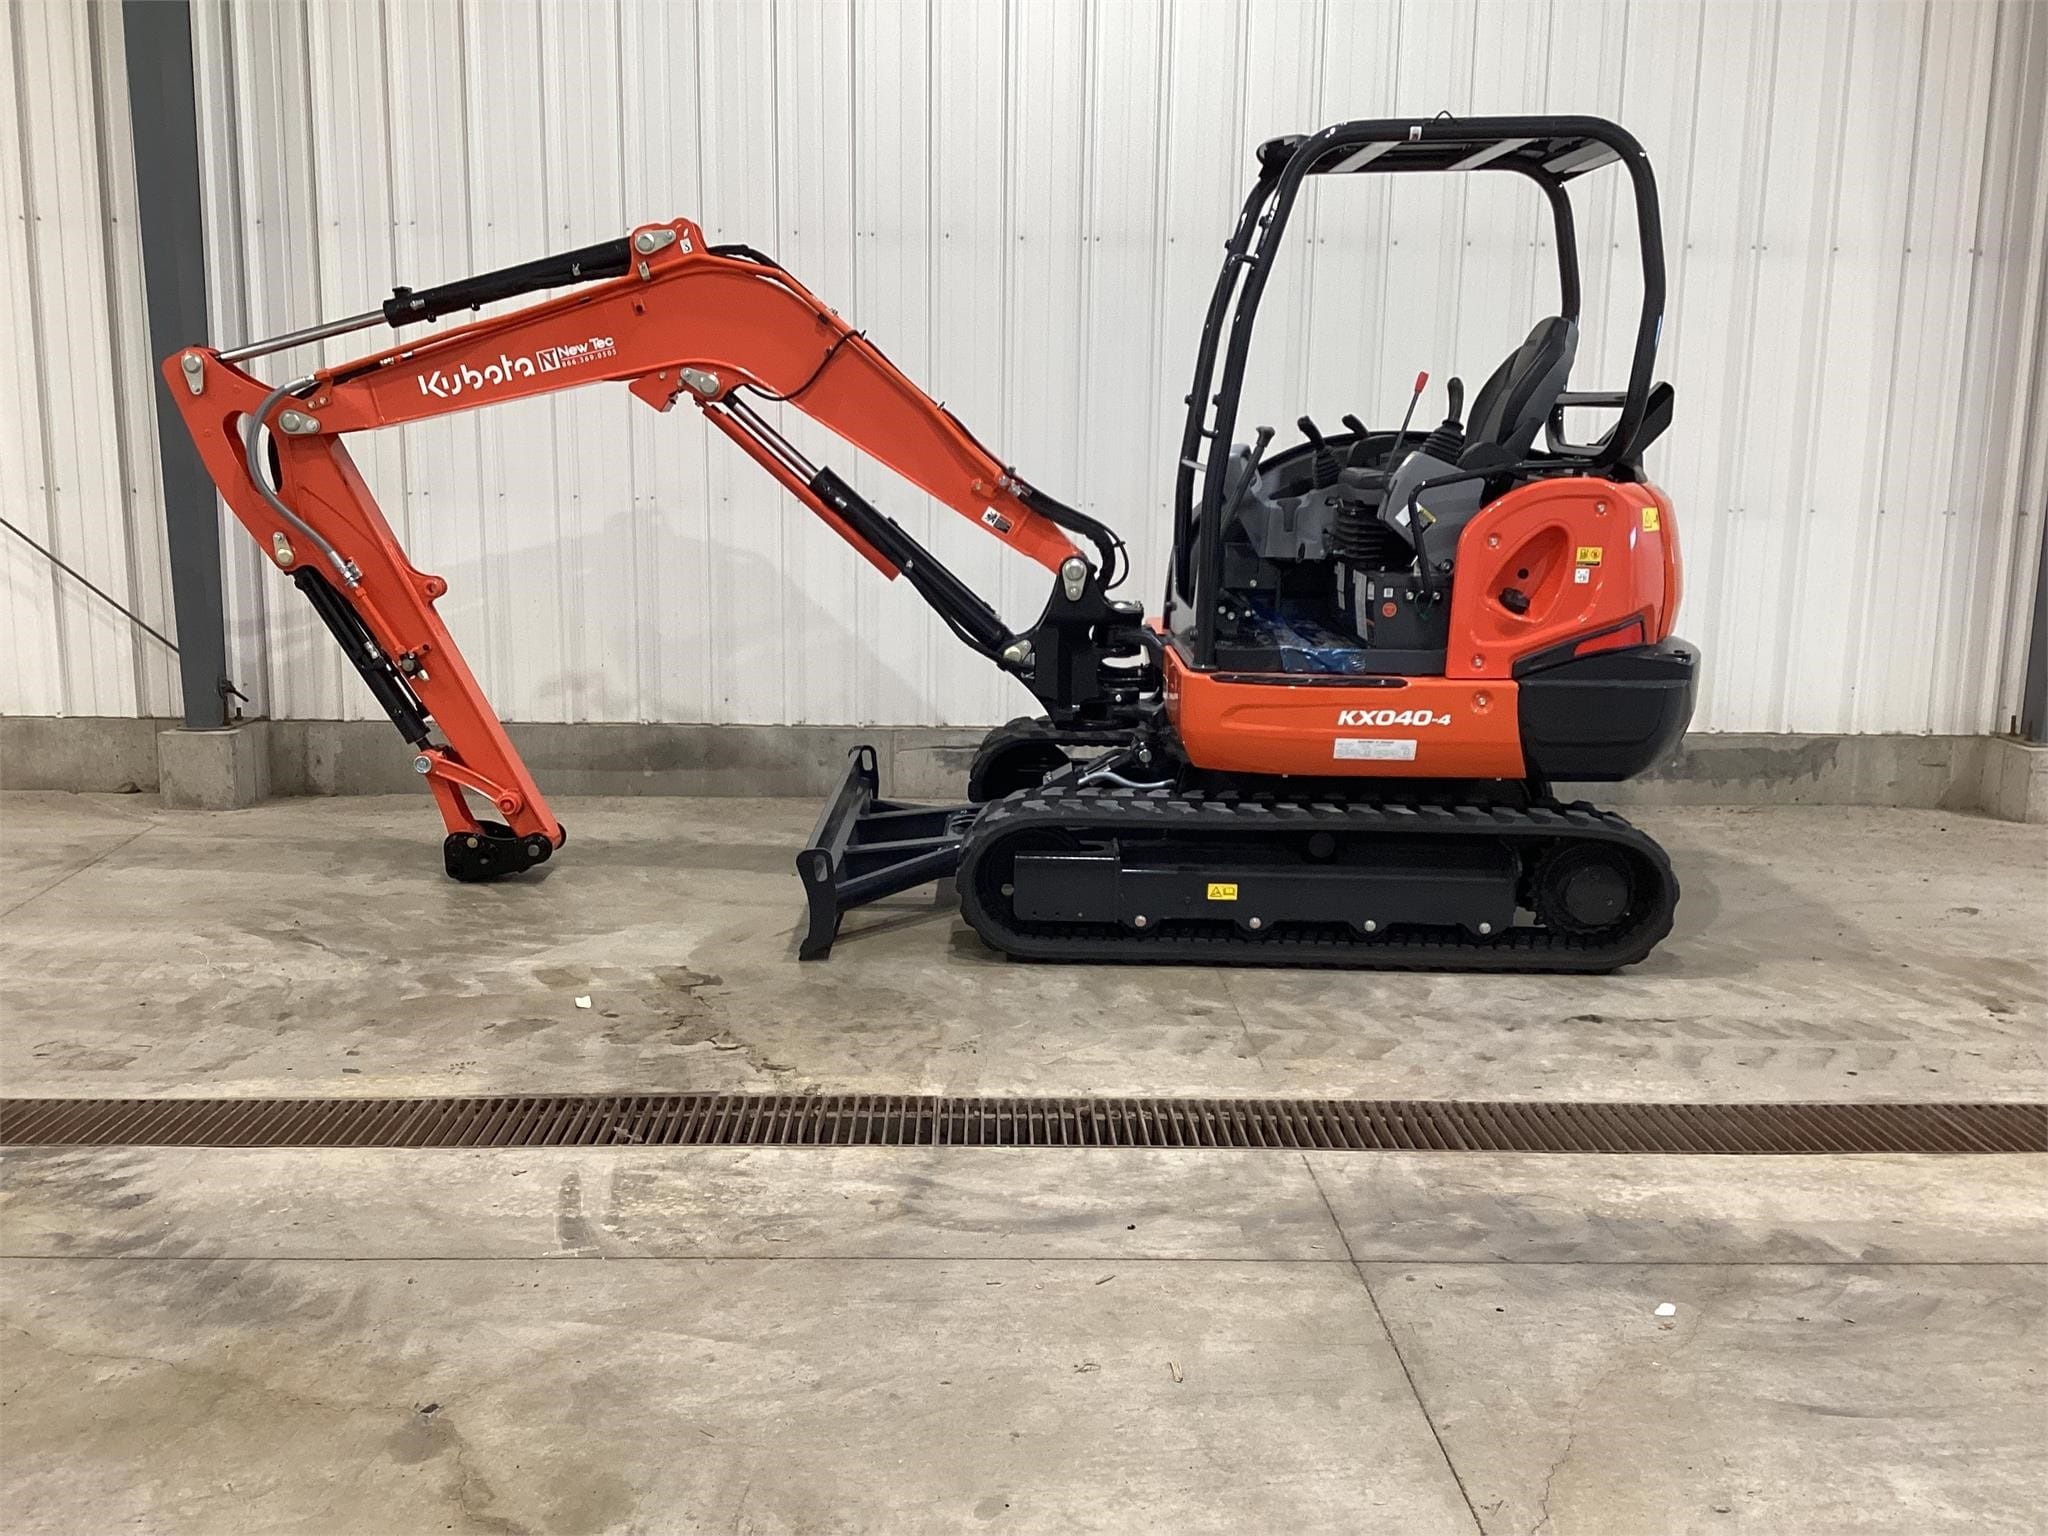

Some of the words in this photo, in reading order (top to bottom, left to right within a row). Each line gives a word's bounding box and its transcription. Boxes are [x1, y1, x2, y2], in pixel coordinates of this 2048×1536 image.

[557, 343, 588, 358] New
[588, 337, 614, 350] Tec
[417, 354, 536, 398] Kubota
[1337, 709, 1451, 726] KX040-4
